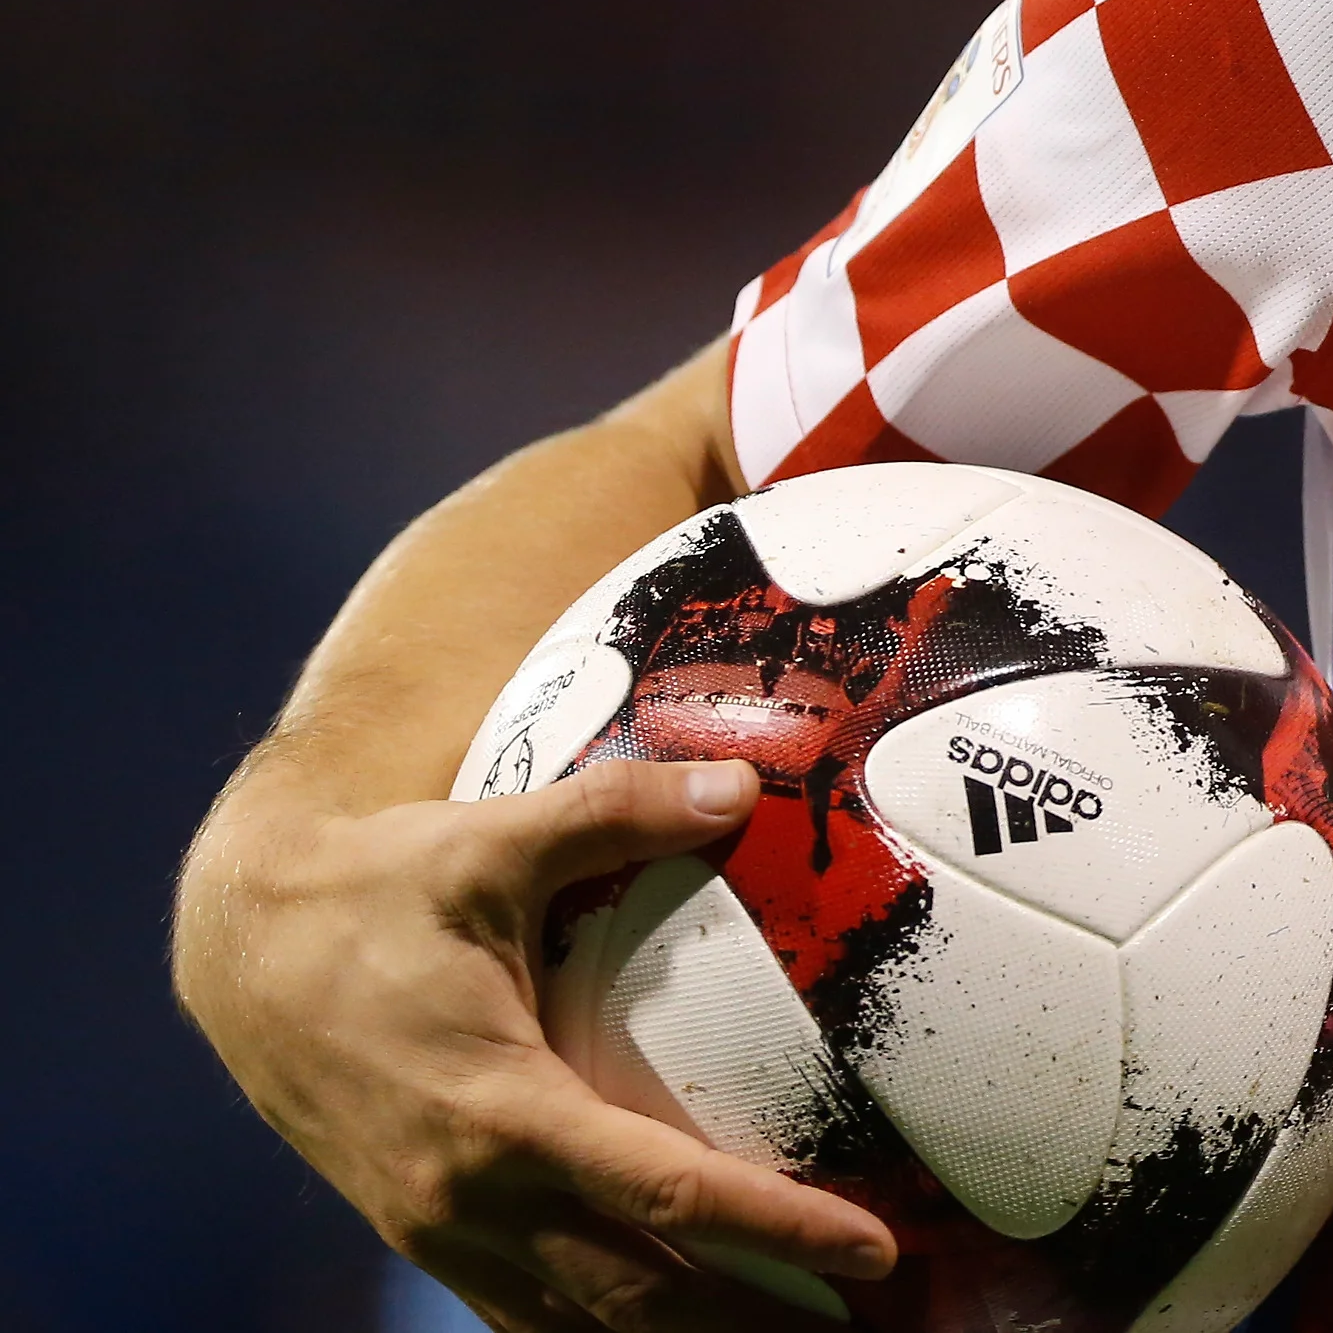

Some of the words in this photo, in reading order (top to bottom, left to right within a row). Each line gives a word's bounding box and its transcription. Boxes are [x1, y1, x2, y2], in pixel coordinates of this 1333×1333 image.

[955, 712, 991, 736] BALL
[993, 727, 1048, 758] MATCH
[947, 735, 1103, 821] adidas
[1050, 750, 1113, 791] OFFICIAL
